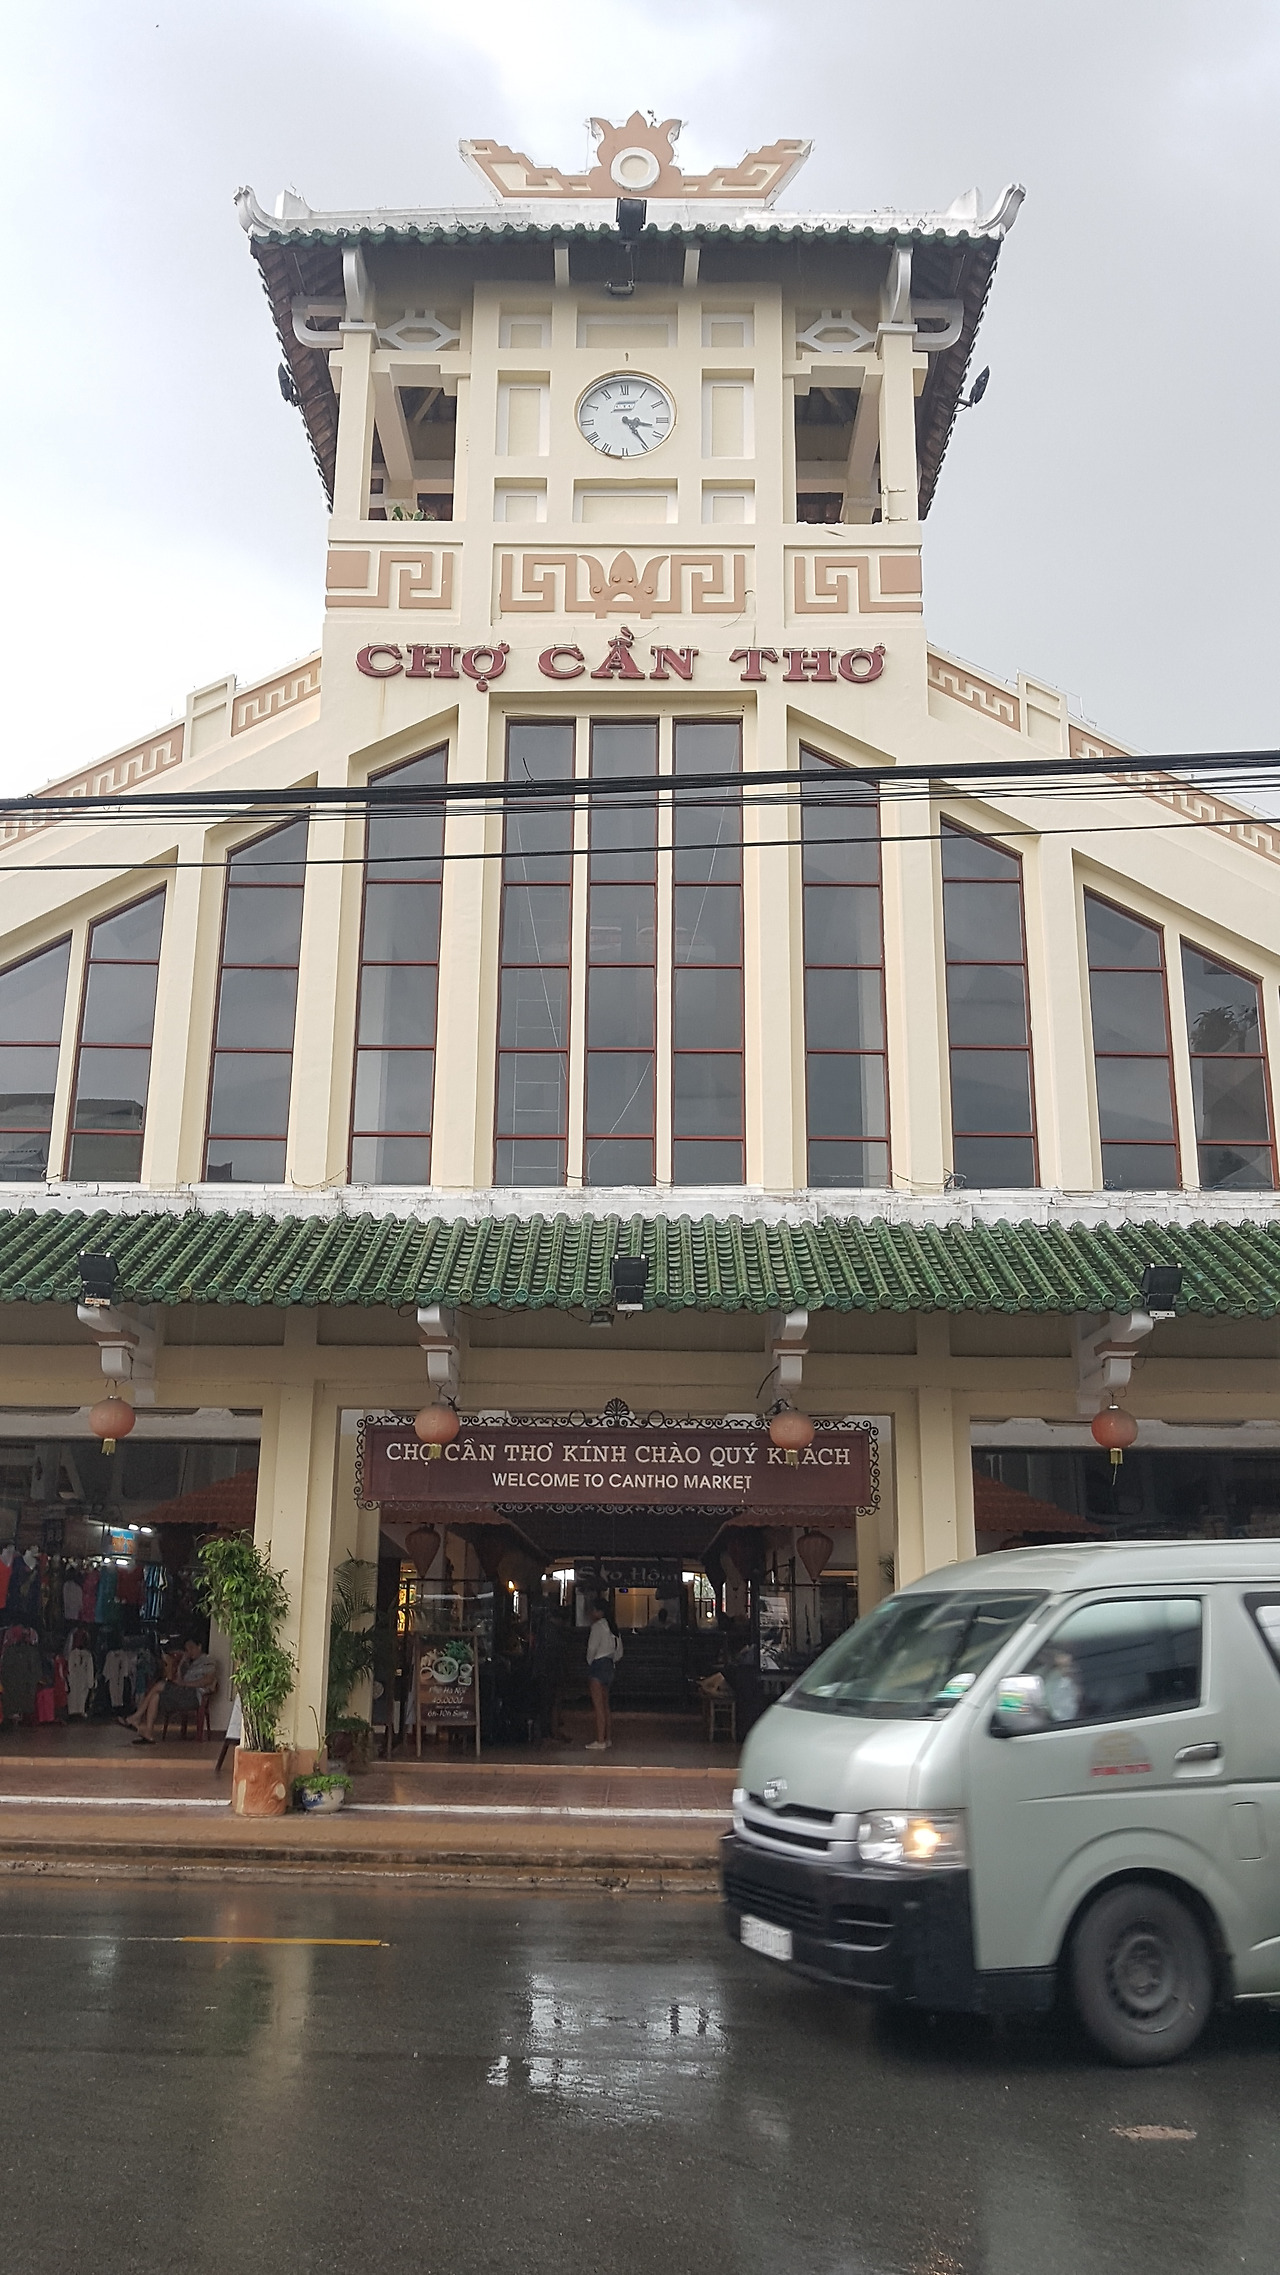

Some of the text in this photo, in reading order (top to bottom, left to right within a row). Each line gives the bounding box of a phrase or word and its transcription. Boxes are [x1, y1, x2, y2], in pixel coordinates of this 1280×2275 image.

[356, 624, 887, 693] CHỢ CẦN THƠ
[444, 1438, 497, 1462] CẦN
[504, 1442, 554, 1463] THƠ
[562, 1439, 627, 1463] KÍNH
[634, 1442, 701, 1464] CHÀO
[709, 1442, 759, 1467] QUÝ
[492, 1473, 752, 1490] WELCOME TO CANTHO MARKET
